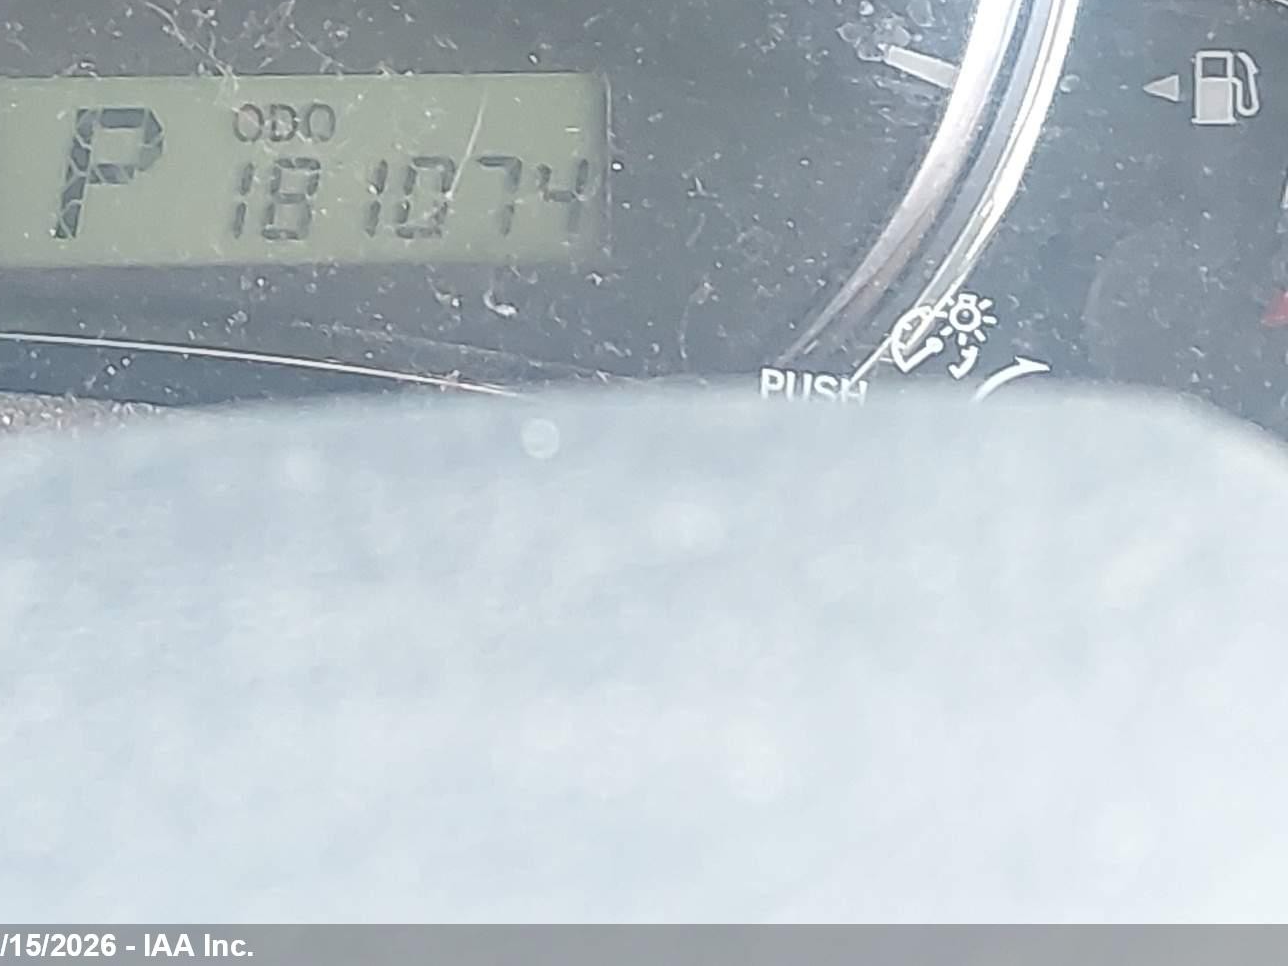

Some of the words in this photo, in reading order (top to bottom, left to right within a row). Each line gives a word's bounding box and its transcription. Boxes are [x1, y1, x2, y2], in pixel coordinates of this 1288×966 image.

[232, 101, 338, 143] ODO
[54, 108, 164, 238] P
[231, 156, 589, 240] 181074
[761, 368, 868, 404] PUSH
